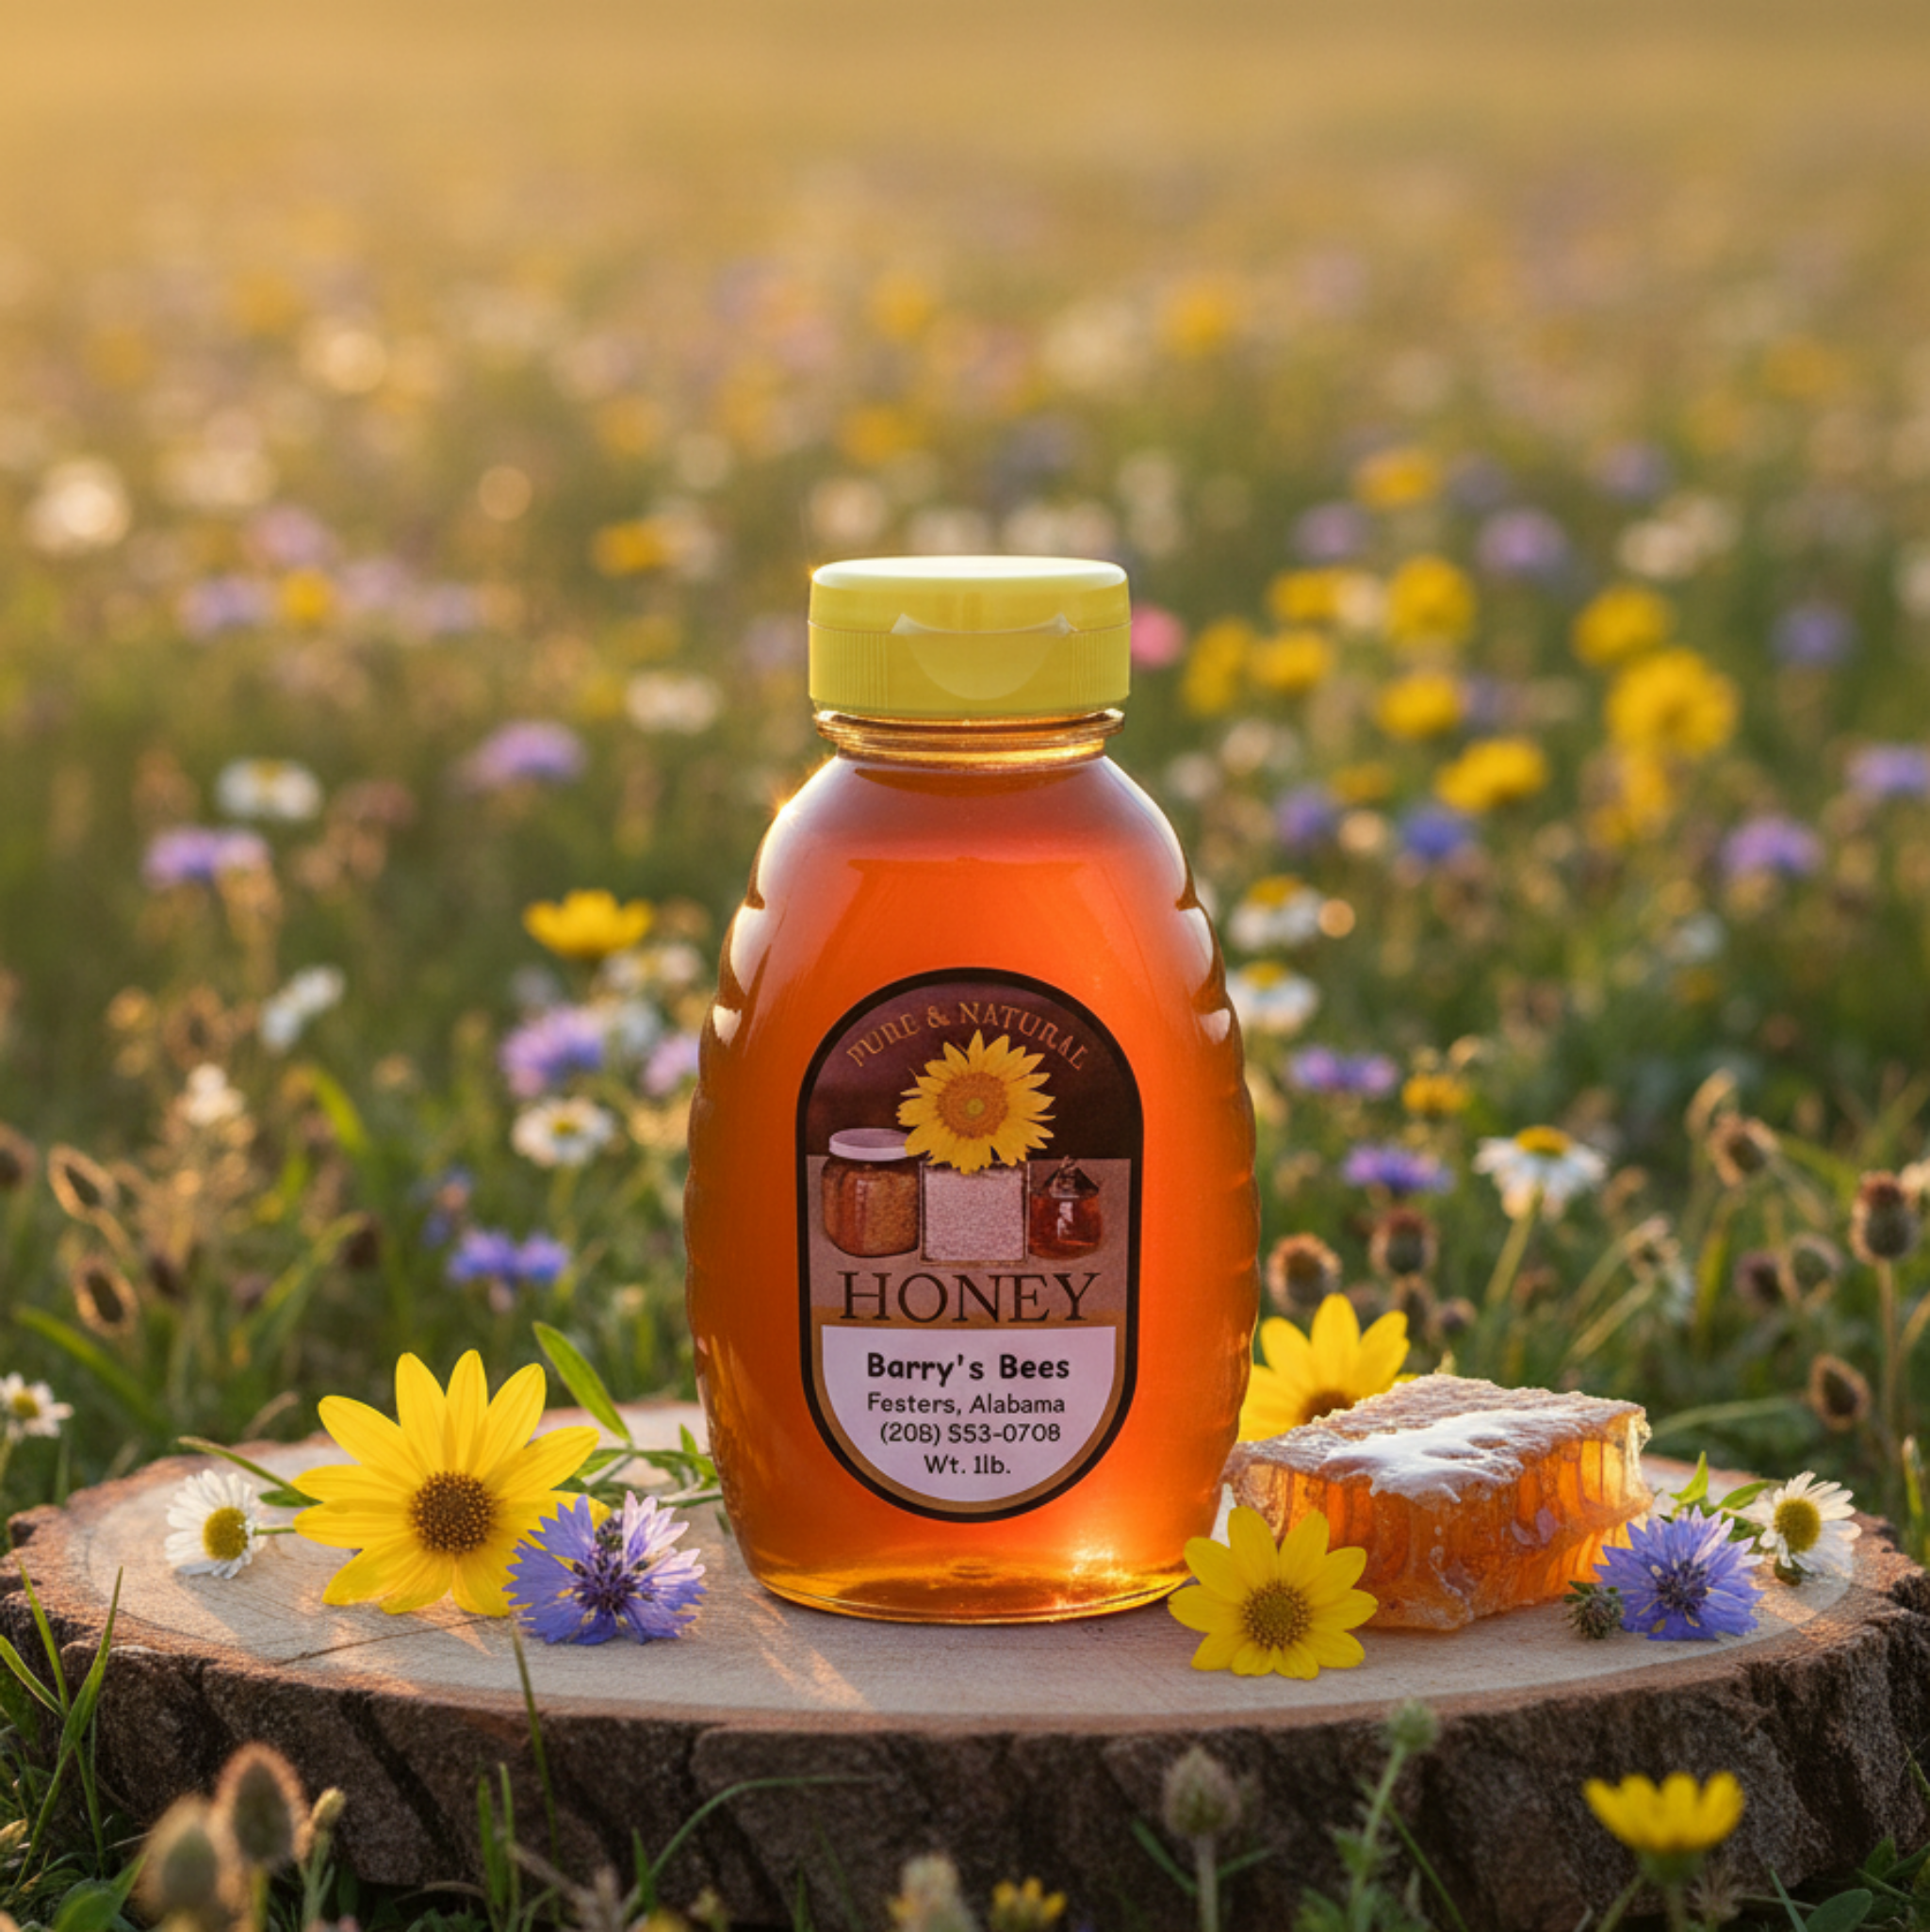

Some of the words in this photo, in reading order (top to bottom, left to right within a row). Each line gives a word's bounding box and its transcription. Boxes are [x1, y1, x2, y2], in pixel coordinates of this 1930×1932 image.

[926, 1005, 951, 1028] &
[959, 1002, 1089, 1072] NATURAL
[838, 1271, 1101, 1322] HONEY
[867, 1351, 985, 1388] Barry's
[999, 1353, 1071, 1380] Bees
[867, 1392, 962, 1416] Festers,
[969, 1394, 1066, 1415] Alabama
[879, 1421, 941, 1447] (208)
[924, 1454, 967, 1475] Wt.
